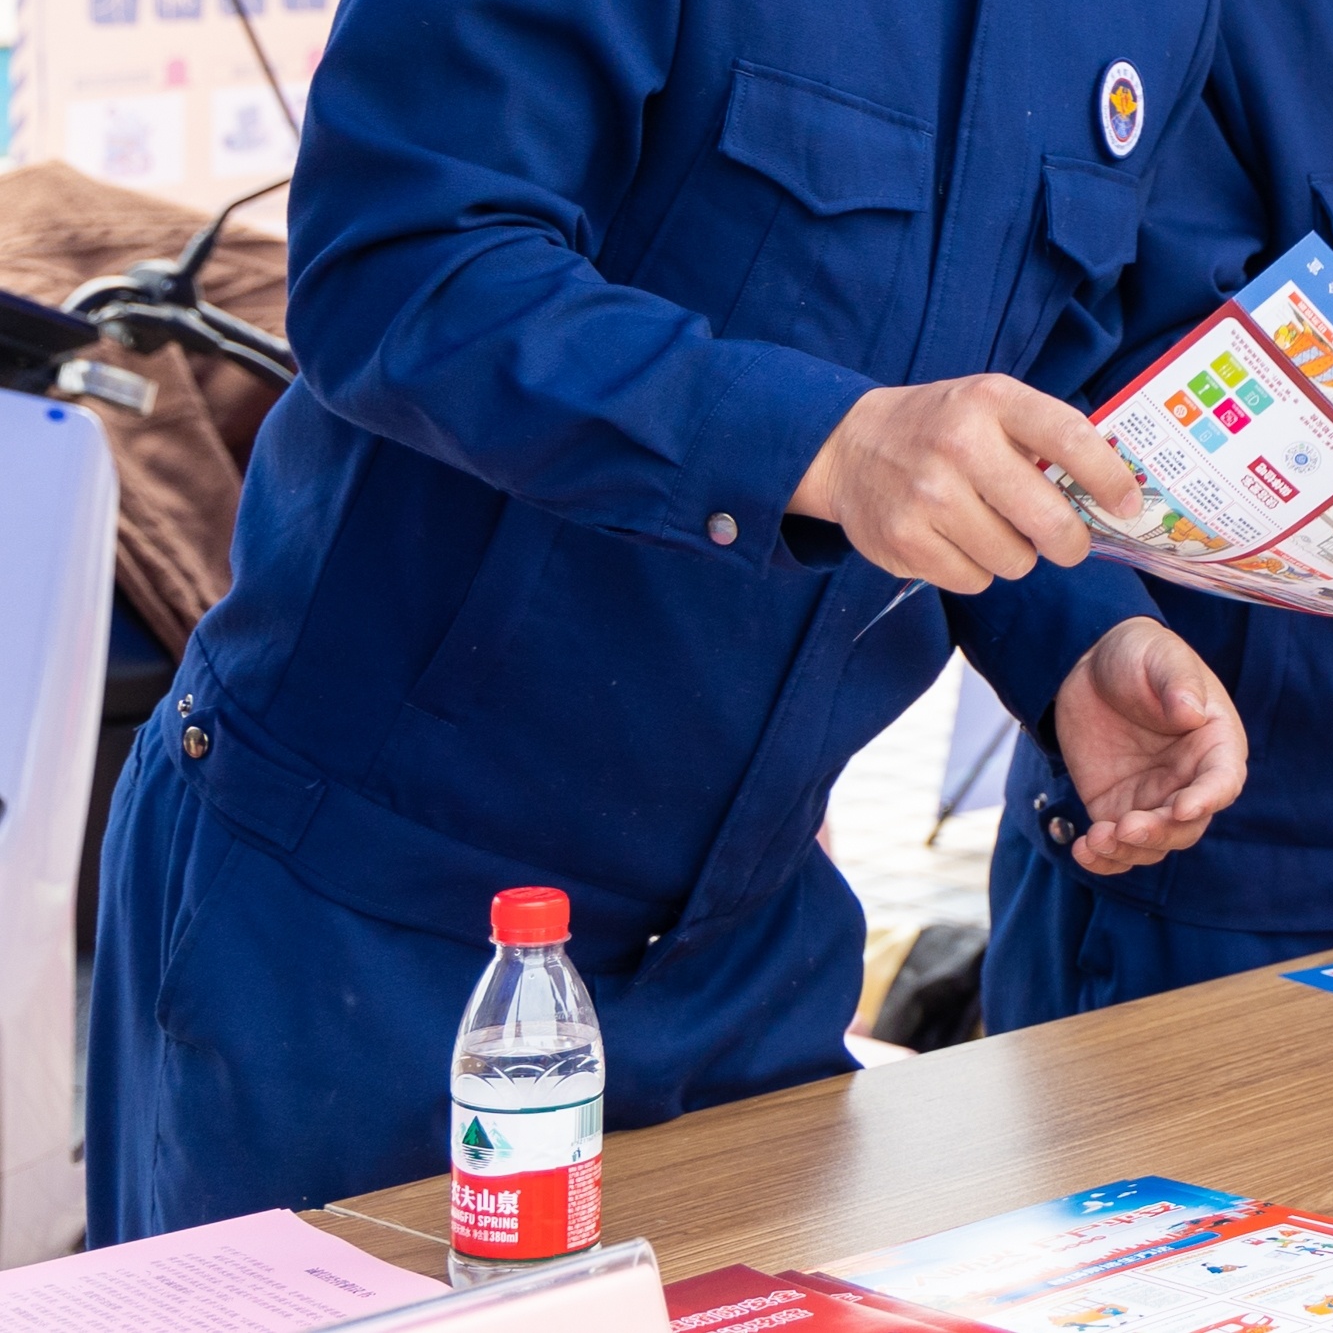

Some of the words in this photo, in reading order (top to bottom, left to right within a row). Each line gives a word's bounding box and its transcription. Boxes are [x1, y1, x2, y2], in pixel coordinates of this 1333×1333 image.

[451, 1180, 520, 1215] 农夫山泉
[477, 1215, 519, 1229] SPRING
